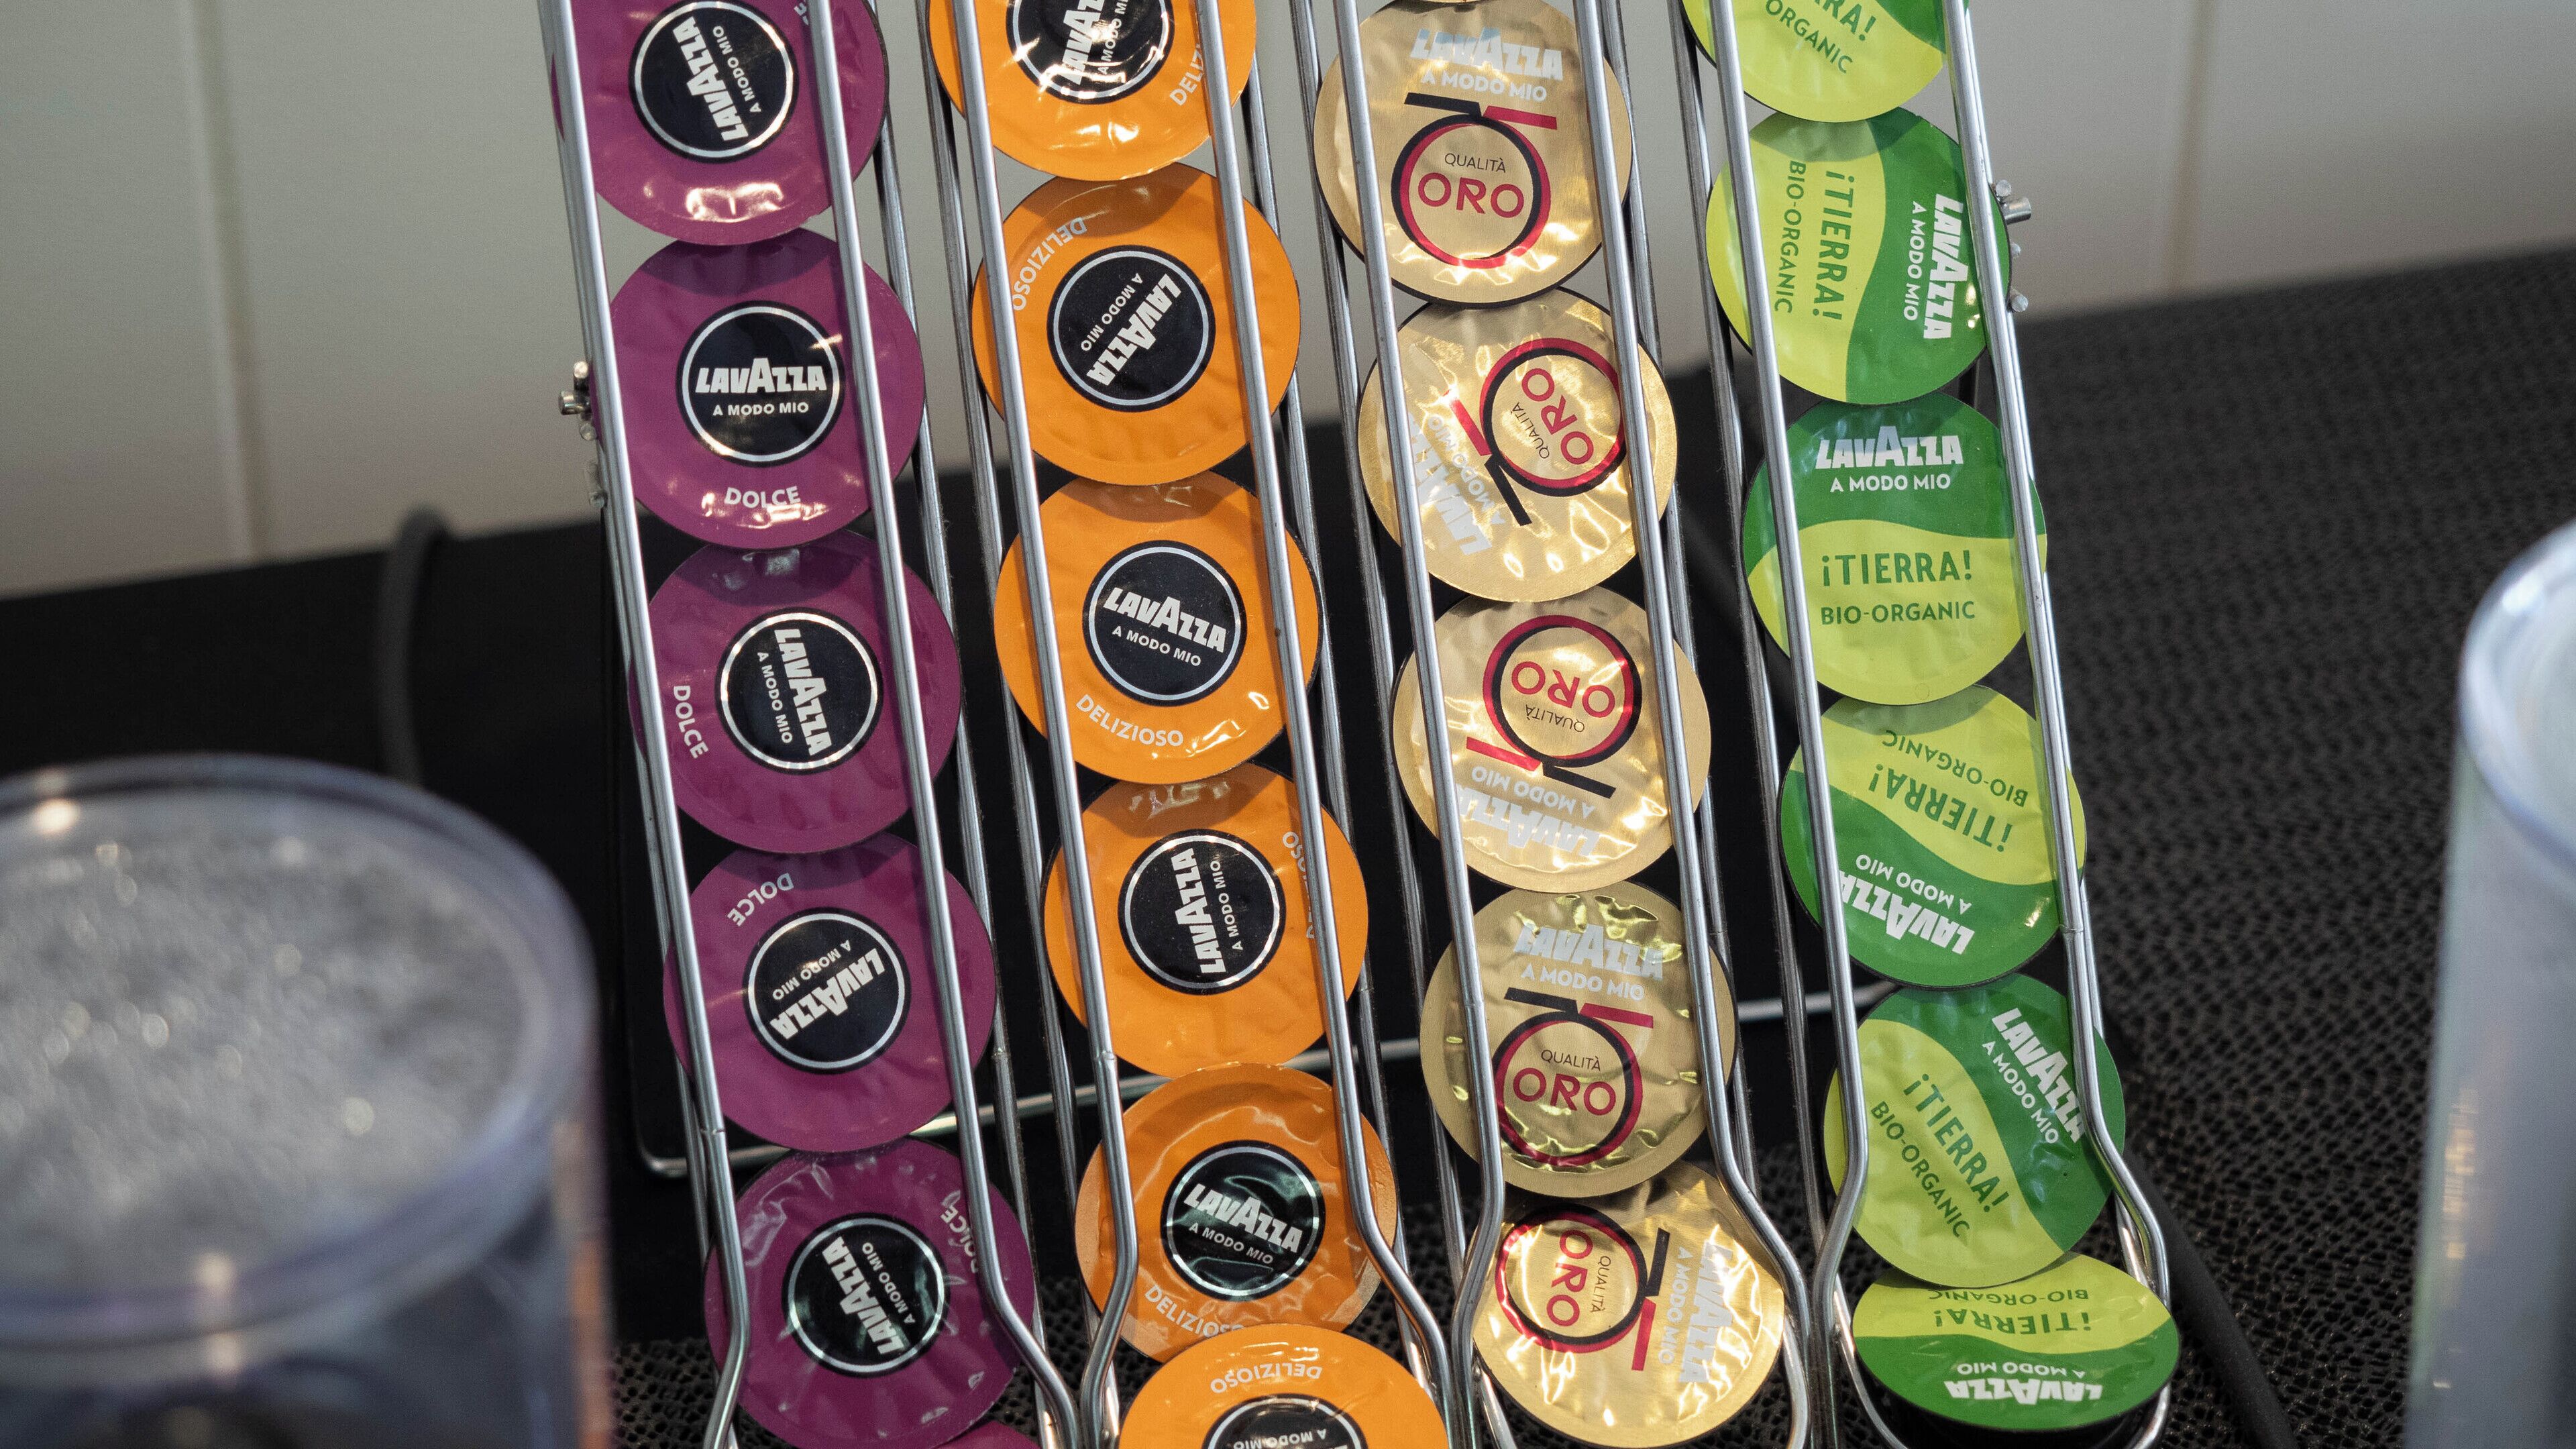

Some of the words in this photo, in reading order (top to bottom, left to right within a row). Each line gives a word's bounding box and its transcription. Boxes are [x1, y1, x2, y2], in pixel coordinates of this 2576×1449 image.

[713, 25, 733, 54] MIO
[1101, 18, 1122, 62] MODO
[1410, 28, 1563, 80] LAVAZZA
[673, 15, 749, 142] LAVAZZA
[726, 56, 755, 103] MODO
[1169, 43, 1203, 106] DELIZ
[1420, 69, 1436, 85] A
[1441, 72, 1505, 95] MODO
[1509, 82, 1547, 102] MIO
[749, 104, 761, 114] A
[1444, 153, 1506, 174] QUALITÀ
[1417, 172, 1525, 219] ORO
[1911, 201, 1927, 214] A
[1774, 160, 1807, 313] BIO-ORGANIC
[1812, 170, 1855, 321] ¡TIERRA!
[1907, 219, 1926, 278] MODO
[1012, 217, 1087, 311] DELIZIOSO
[1132, 273, 1144, 284] A
[1923, 193, 1969, 339] LAVAZZA
[1102, 284, 1137, 325] MODO
[1903, 284, 1921, 321] MIO
[1081, 324, 1104, 352] MIO
[1085, 273, 1181, 386] LAVAZZA
[696, 358, 826, 393] LAVAZZA
[712, 405, 723, 415] A
[729, 403, 775, 415] MODO
[780, 402, 808, 414] MIO
[1521, 368, 1594, 465] ORO
[1426, 415, 1458, 450] MIO
[1512, 402, 1550, 460] QUALITÀ
[1815, 425, 1964, 470] LAVAZZA
[724, 486, 801, 508] DOLCE
[1454, 453, 1497, 511] MODO
[1830, 477, 1844, 492] A
[1849, 475, 1908, 492] MODO
[1914, 474, 1951, 490] MIO
[1491, 511, 1506, 525] A
[1821, 549, 1972, 586] ¡TIERRA!
[1103, 588, 1226, 653] LAVAZZA
[1821, 601, 1976, 625] BIO-ORGANIC
[757, 652, 767, 661] A
[1112, 626, 1123, 637] A
[1126, 629, 1170, 655] MODO
[1174, 647, 1201, 667] MIO
[761, 665, 783, 711] MODO
[774, 629, 833, 756] LAVAZZA
[1511, 661, 1615, 718] ORO
[673, 685, 708, 759] DOLCE
[775, 715, 792, 743] MIO
[1075, 694, 1183, 747] DELIZIOSO
[1525, 704, 1585, 733] QUALITÀ
[1471, 766, 1512, 791] MIO
[1882, 730, 2029, 807] BIO-ORGANIC
[1515, 781, 1576, 811] MODO
[1580, 803, 1595, 819] A
[1868, 763, 2012, 852] ¡TIERRA!
[1210, 860, 1226, 889] MIO
[1856, 854, 1894, 880] MIO
[727, 873, 794, 926] DOLCE
[1895, 871, 1954, 907] MODO
[1959, 898, 1972, 915] A
[1171, 848, 1226, 973] LAVAZZA
[1219, 893, 1242, 938] MODO
[800, 948, 846, 981] MODO
[840, 940, 851, 951] A
[1232, 940, 1243, 951] A
[1513, 923, 1664, 981] LAVAZZA
[769, 948, 885, 1040] LAVAZZA
[773, 977, 800, 1001] MIO
[1521, 963, 1535, 980] A
[1540, 966, 1603, 993] MODO
[1606, 981, 1645, 1001] MIO
[1541, 1049, 1601, 1072] QUALITÀ
[1991, 1007, 2085, 1143] LAVAZZA
[1513, 1067, 1617, 1116] ORO
[1982, 1041, 1995, 1056] A
[1992, 1055, 2036, 1109] MODO
[2031, 1110, 2059, 1144] MIO
[1904, 1073, 2009, 1213] ¡TIERRA!
[1870, 1101, 1971, 1238] BIO-ORGANIC
[1183, 1183, 1303, 1253] LAVAZZA
[861, 1242, 885, 1271] MIO
[1189, 1222, 1199, 1232] A
[1202, 1226, 1244, 1252] MODO
[1245, 1245, 1274, 1265] MIO
[1677, 1246, 1688, 1260] A
[821, 1236, 905, 1354] LAVAZZA
[878, 1271, 909, 1313] MODO
[1546, 1229, 1593, 1327] ORO
[1591, 1256, 1612, 1313] QUALITÀ
[1667, 1263, 1690, 1323] MODO
[1929, 1289, 2088, 1305] BIO-ORGANIC
[903, 1313, 916, 1324] A
[1934, 1309, 2092, 1335] ¡TIERRA!
[1658, 1326, 1679, 1364] MIO
[1210, 1362, 1323, 1394] DELIZIOSO
[1957, 1362, 1997, 1374] MIO
[2002, 1362, 2068, 1377] MODO
[2073, 1370, 2086, 1378] A
[1944, 1377, 2103, 1404] LAVAZZA
[1264, 1431, 1313, 1448] MODO
[1317, 1428, 1327, 1440] A
